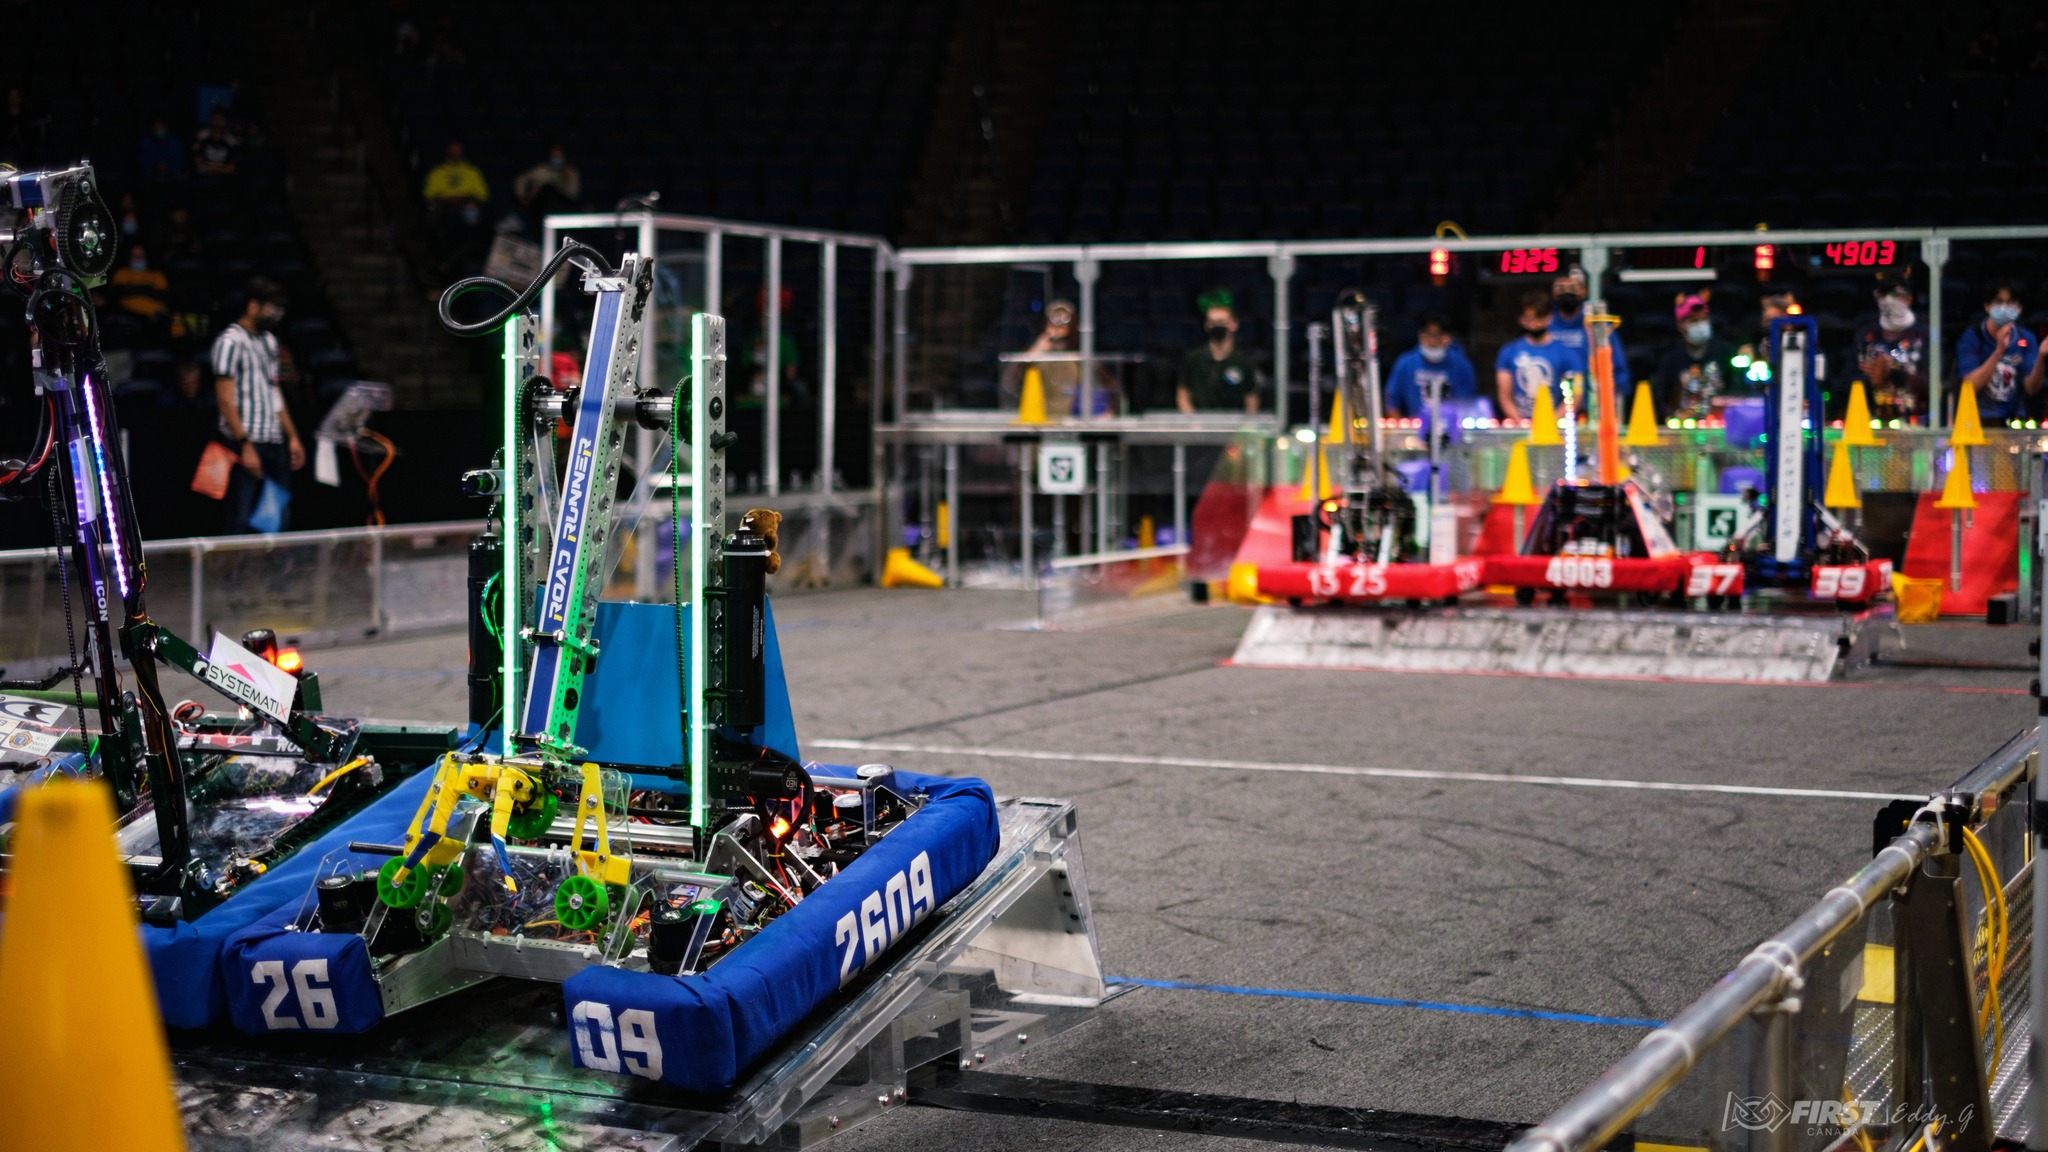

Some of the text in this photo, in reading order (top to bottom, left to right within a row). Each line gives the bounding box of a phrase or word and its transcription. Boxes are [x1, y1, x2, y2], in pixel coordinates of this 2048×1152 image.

[1501, 248, 1559, 274] 1325
[1694, 246, 1705, 269] 1
[1825, 240, 1896, 266] 4903
[562, 437, 592, 543] RUNNER
[549, 549, 571, 622] ROAD
[1545, 557, 1613, 588] 4903
[1687, 564, 1741, 596] 37
[1814, 567, 1866, 597] 39
[95, 580, 109, 622] ICON
[208, 665, 289, 719] SYSTEMATIX
[835, 850, 935, 992] 2609
[251, 959, 339, 1030] 26
[572, 1001, 663, 1080] 09
